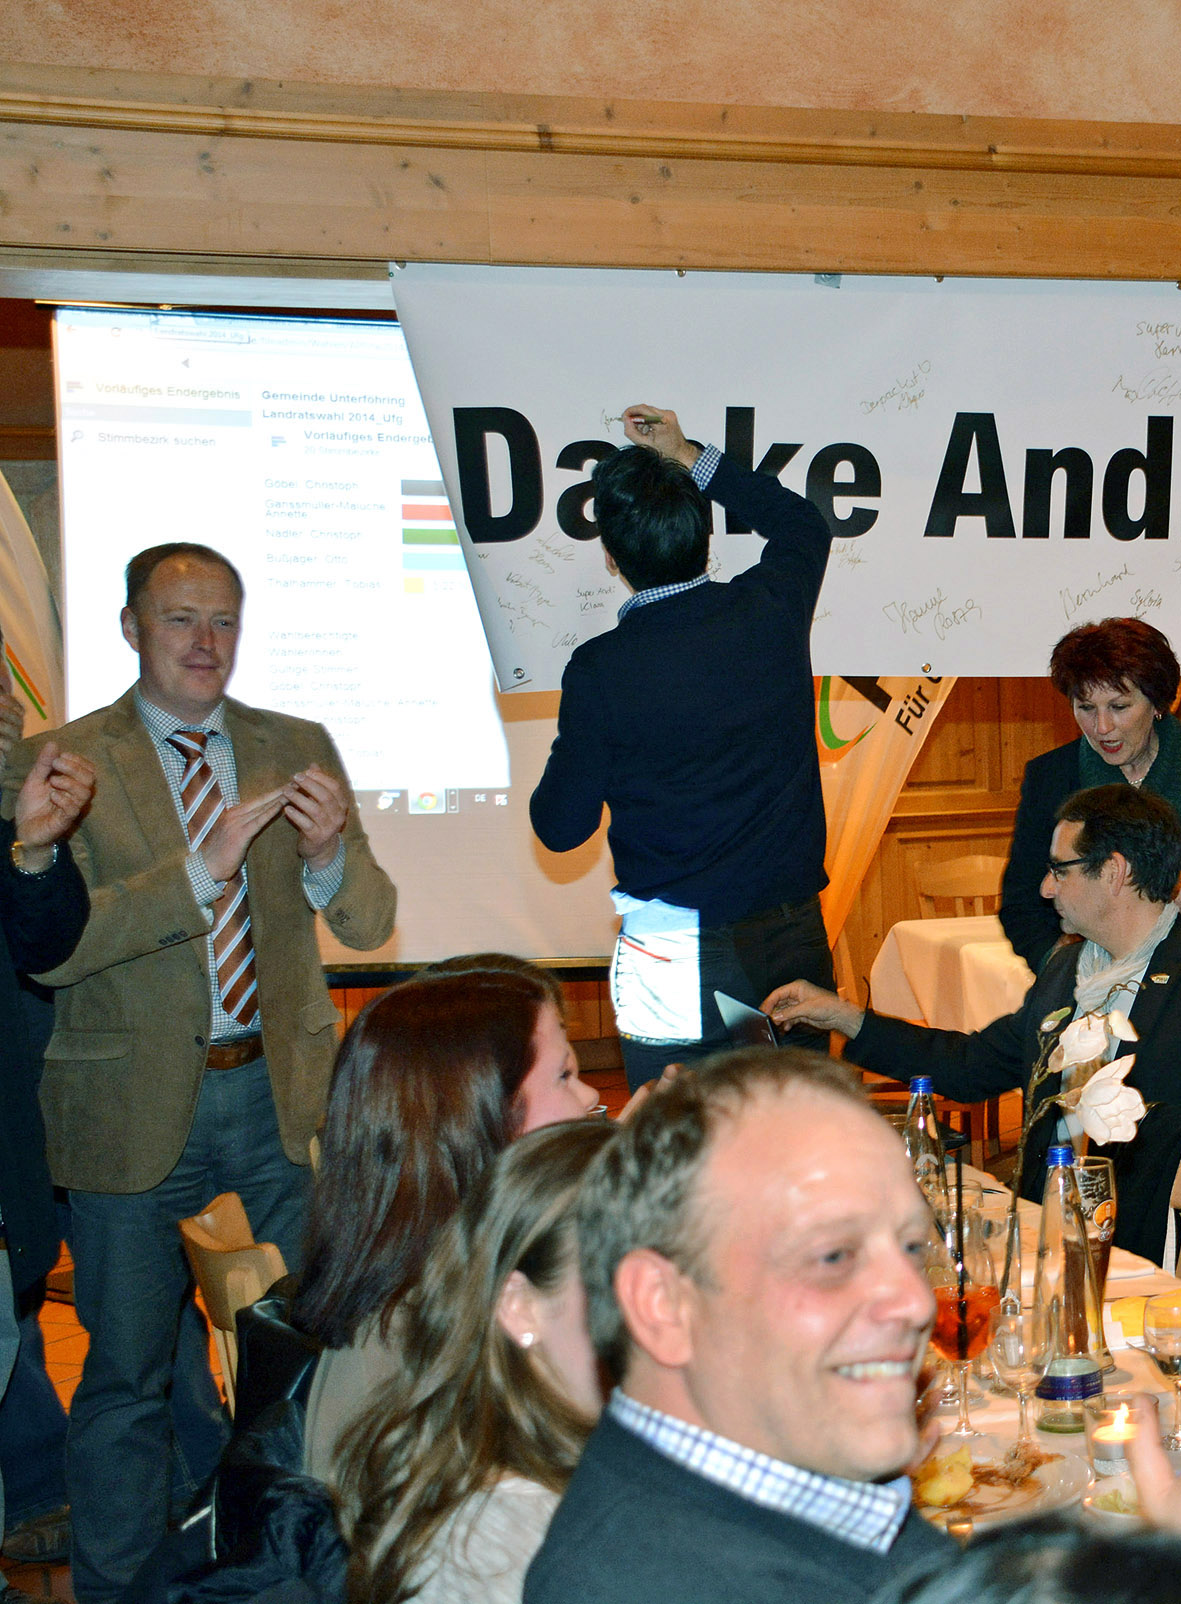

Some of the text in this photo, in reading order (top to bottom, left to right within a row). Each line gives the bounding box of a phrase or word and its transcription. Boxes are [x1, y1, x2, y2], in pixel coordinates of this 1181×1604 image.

[95, 383, 241, 401] Vorläufiges Endergebnis
[261, 390, 326, 403] Gemeinde
[262, 409, 403, 426] Landratswahl 2014_Ufg
[98, 432, 216, 447] Stimmbezirk suchen
[304, 430, 373, 444] Vorläufiges
[453, 405, 882, 545] Dake
[893, 685, 930, 737] Für
